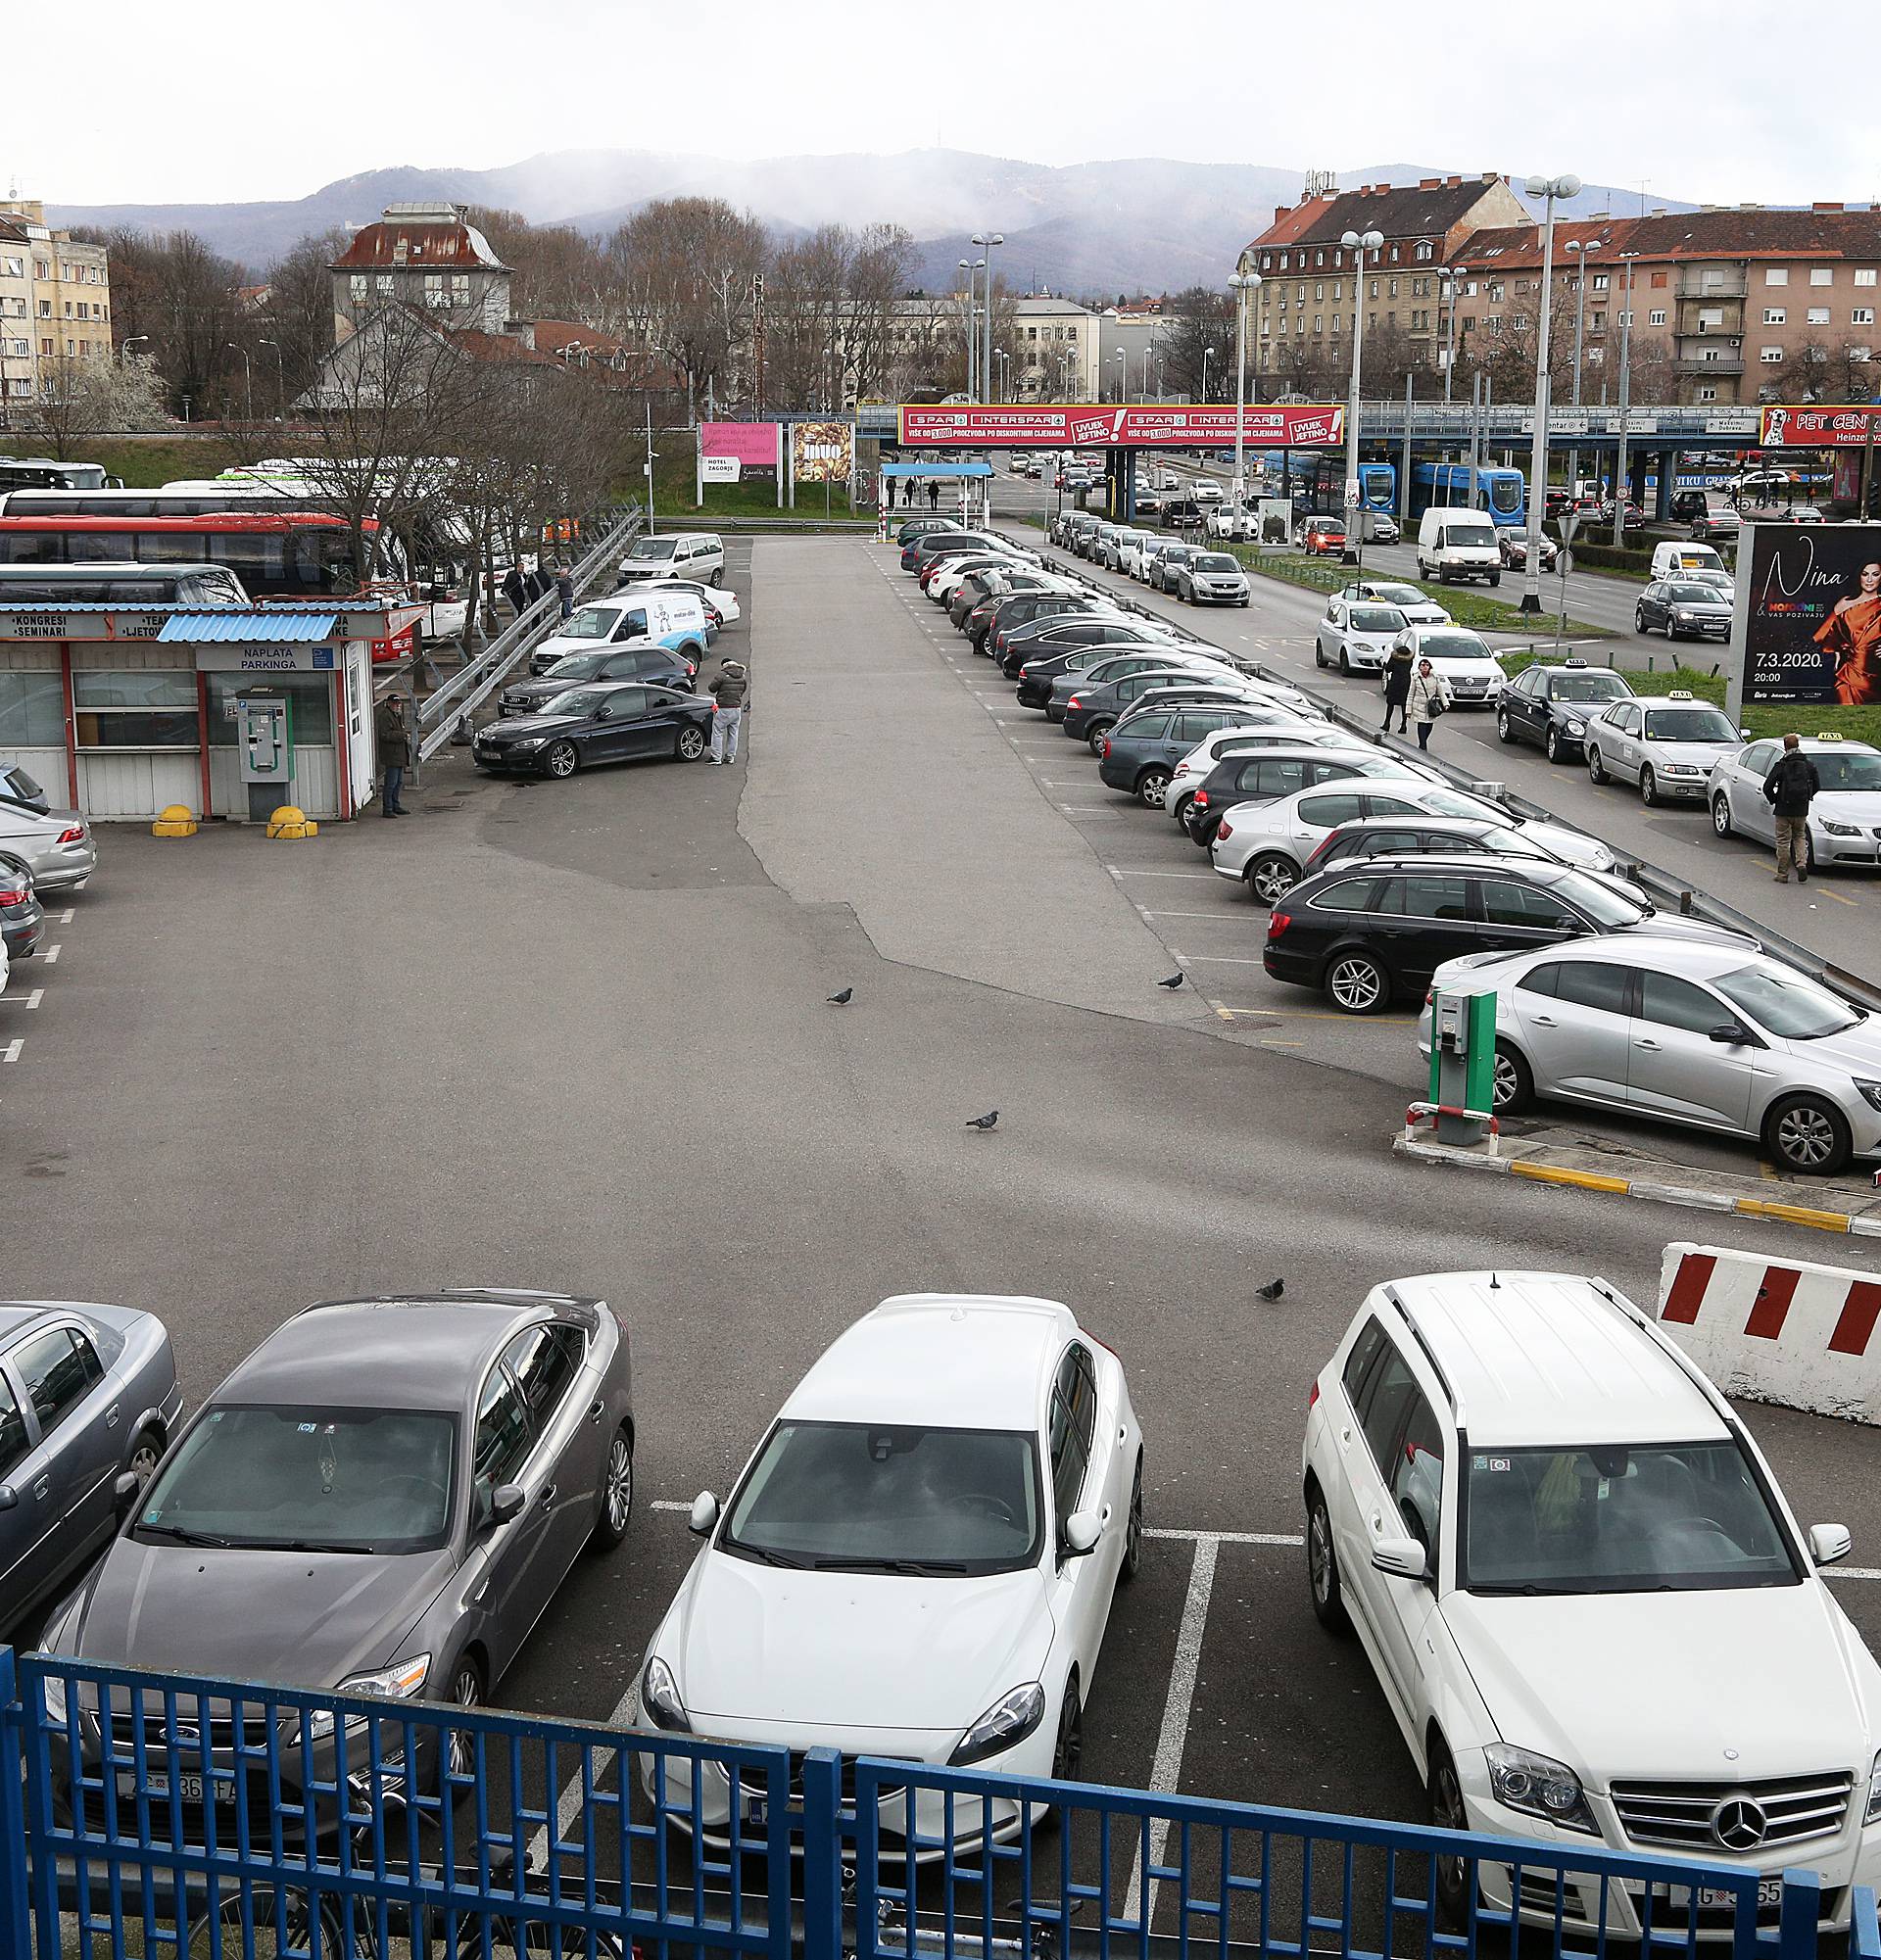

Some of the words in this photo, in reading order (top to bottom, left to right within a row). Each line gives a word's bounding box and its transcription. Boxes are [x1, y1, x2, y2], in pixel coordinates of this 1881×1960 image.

[1076, 420, 1104, 433] UVIJEK
[1293, 420, 1322, 433] UVIJEK
[1796, 413, 1828, 430] PET
[908, 428, 922, 437] VIŠE
[932, 428, 951, 438] 3.000
[1128, 428, 1141, 437] VIŠE
[1150, 428, 1171, 438] 3.000
[1761, 536, 1850, 600] Nina
[1757, 601, 1765, 617] &
[16, 616, 67, 626] KONGRESI
[18, 627, 66, 637] SEMINARI
[244, 648, 293, 657] NAPLATA
[241, 660, 297, 669] PARKINGA
[1755, 652, 1823, 668] 7.3.2020.
[1754, 673, 1781, 682] 20:00
